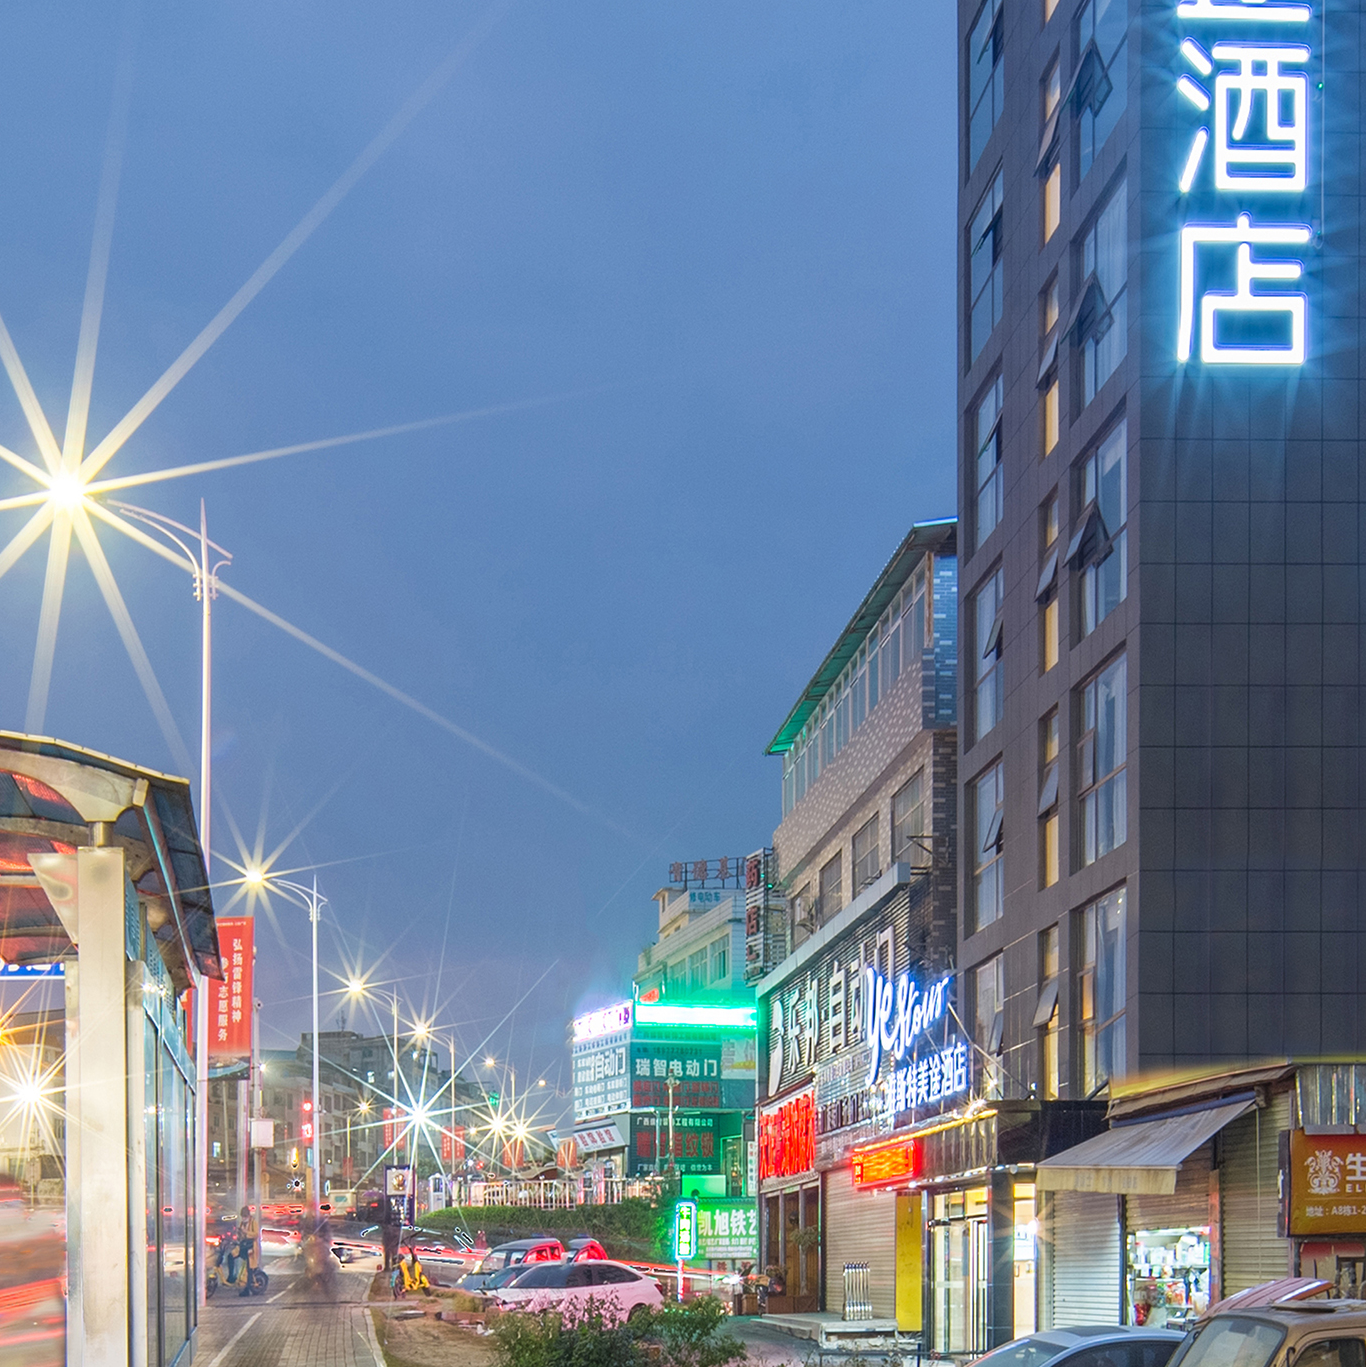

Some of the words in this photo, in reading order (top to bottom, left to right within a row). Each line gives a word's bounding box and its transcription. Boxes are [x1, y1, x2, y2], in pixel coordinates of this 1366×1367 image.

[232, 938, 243, 1023] 弘扬雷锋精神
[635, 1058, 718, 1077] 瑞智电动门
[887, 1041, 968, 1115] 雅斯特美途酒店
[697, 1209, 758, 1236] 凯旭铁艺
